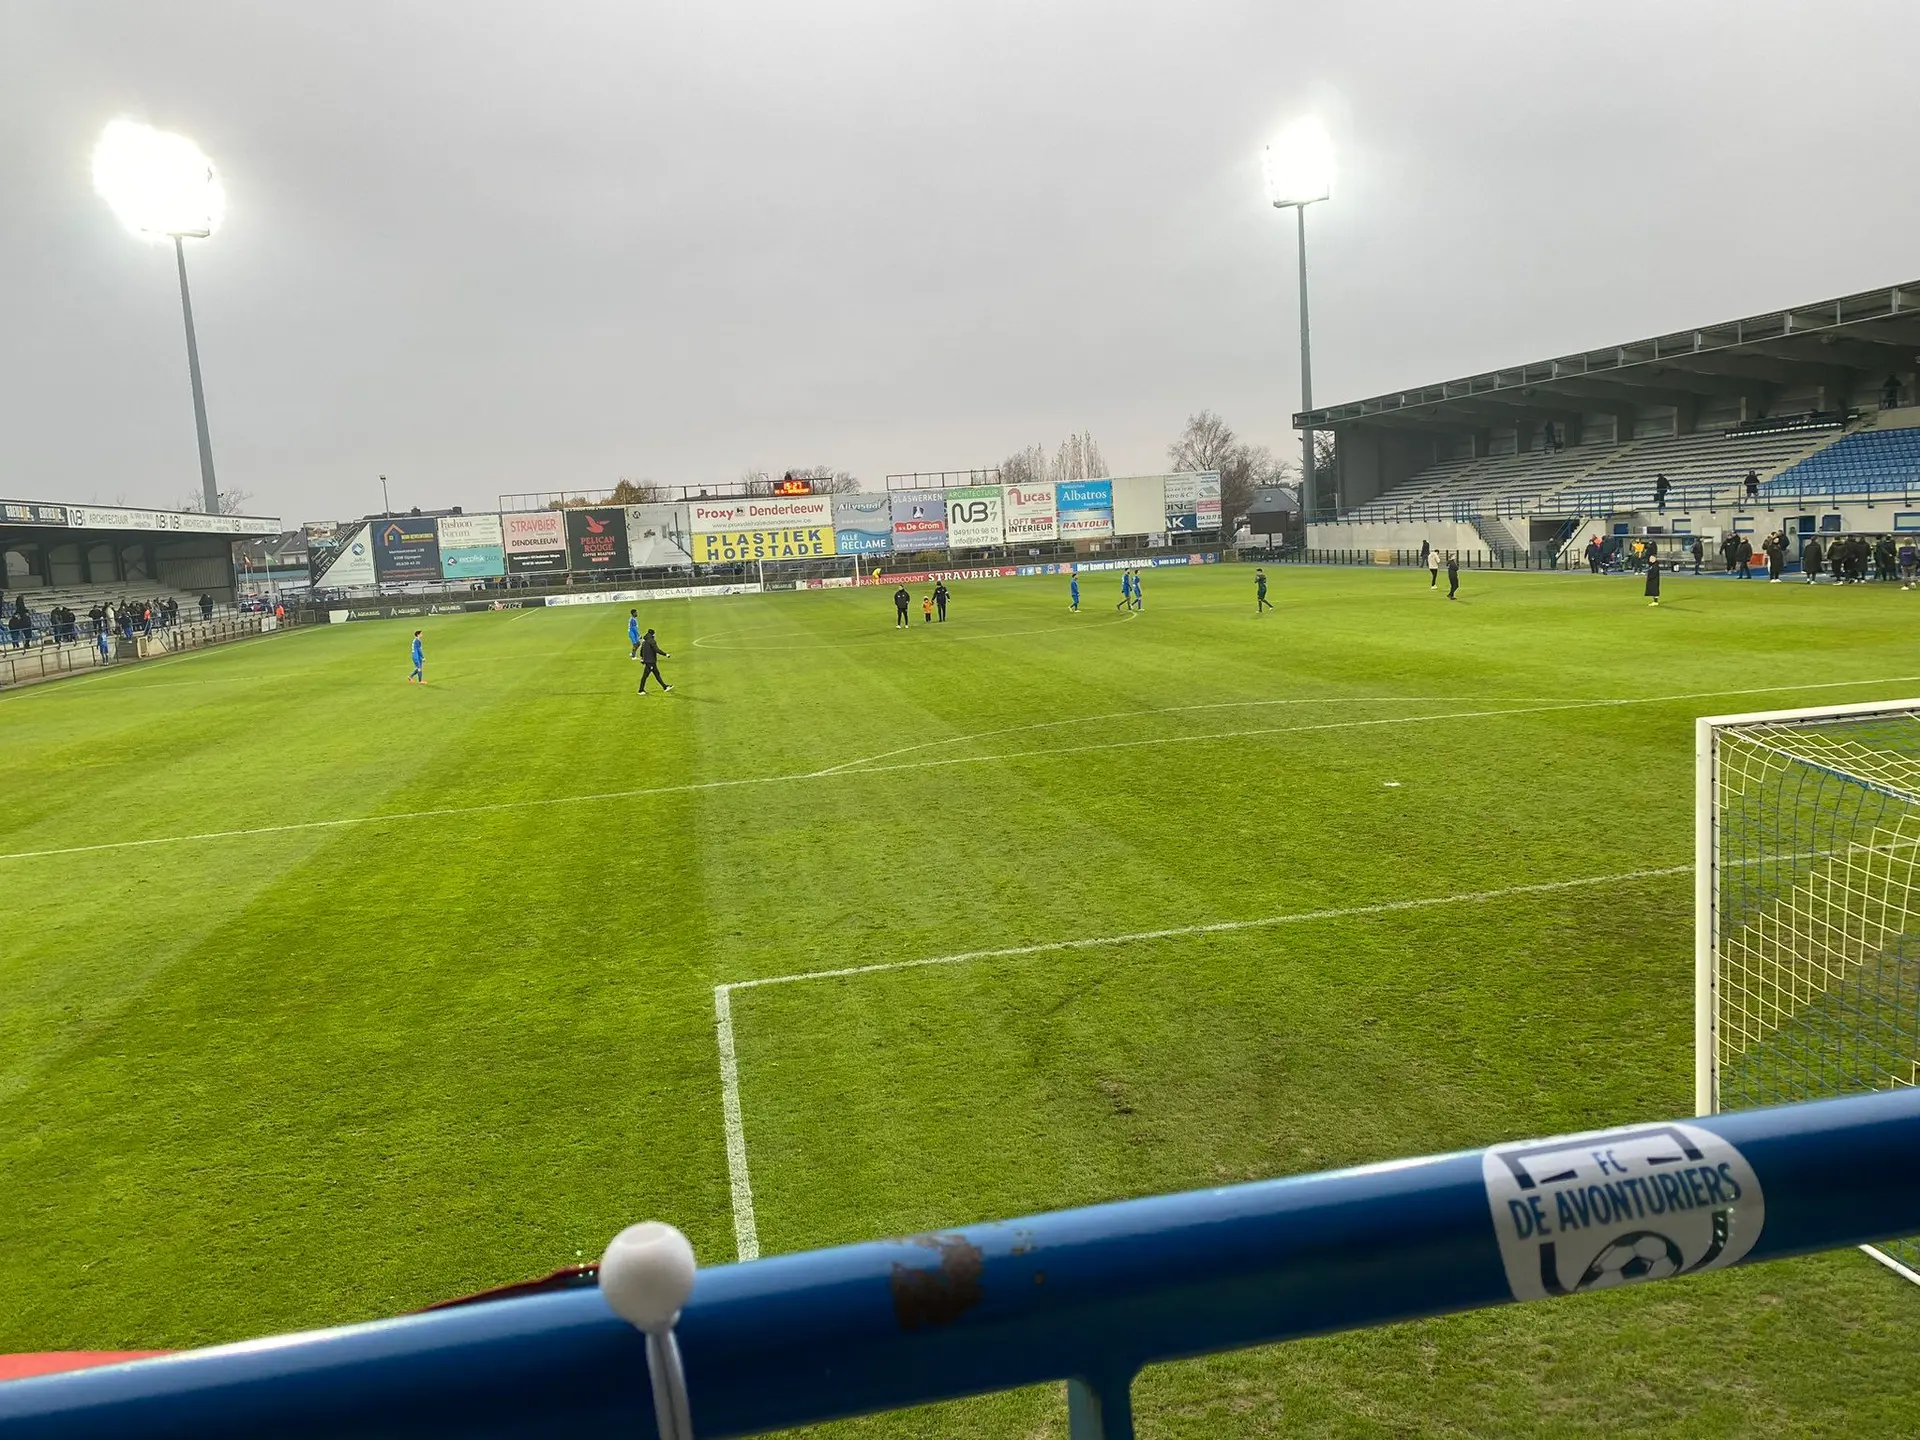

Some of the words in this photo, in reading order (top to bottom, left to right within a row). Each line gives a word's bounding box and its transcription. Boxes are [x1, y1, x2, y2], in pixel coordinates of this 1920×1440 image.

[893, 493, 943, 503] GLASWERKEN
[948, 489, 999, 498] ARCHITECTUUR
[1008, 488, 1052, 505] Lucas
[1062, 490, 1107, 501] Albatros
[697, 508, 734, 520] Proxy
[750, 504, 824, 516] Denderleeuw
[89, 513, 129, 525] ARCHITECTUUR
[441, 518, 473, 529] Fashion
[1008, 517, 1029, 526] LOFT
[1062, 519, 1109, 529] RANTOUR
[511, 518, 557, 533] STRAVBIER
[1008, 523, 1053, 533] INTERIEUR
[442, 530, 470, 538] Forum
[706, 529, 822, 548] PLASTIEK
[511, 537, 559, 547] DENDERLEEUW
[580, 535, 616, 545] PELICAN
[841, 539, 887, 550] RECLAME
[584, 543, 614, 552] ROUGE
[707, 542, 824, 561] HOFSTADE
[855, 575, 925, 587] RANENDISCOUNT
[928, 569, 1001, 582] STRAVBIER
[1591, 1149, 1628, 1176] FC
[1507, 1194, 1553, 1241] DE
[1554, 1162, 1743, 1233] AVONTURIERS
